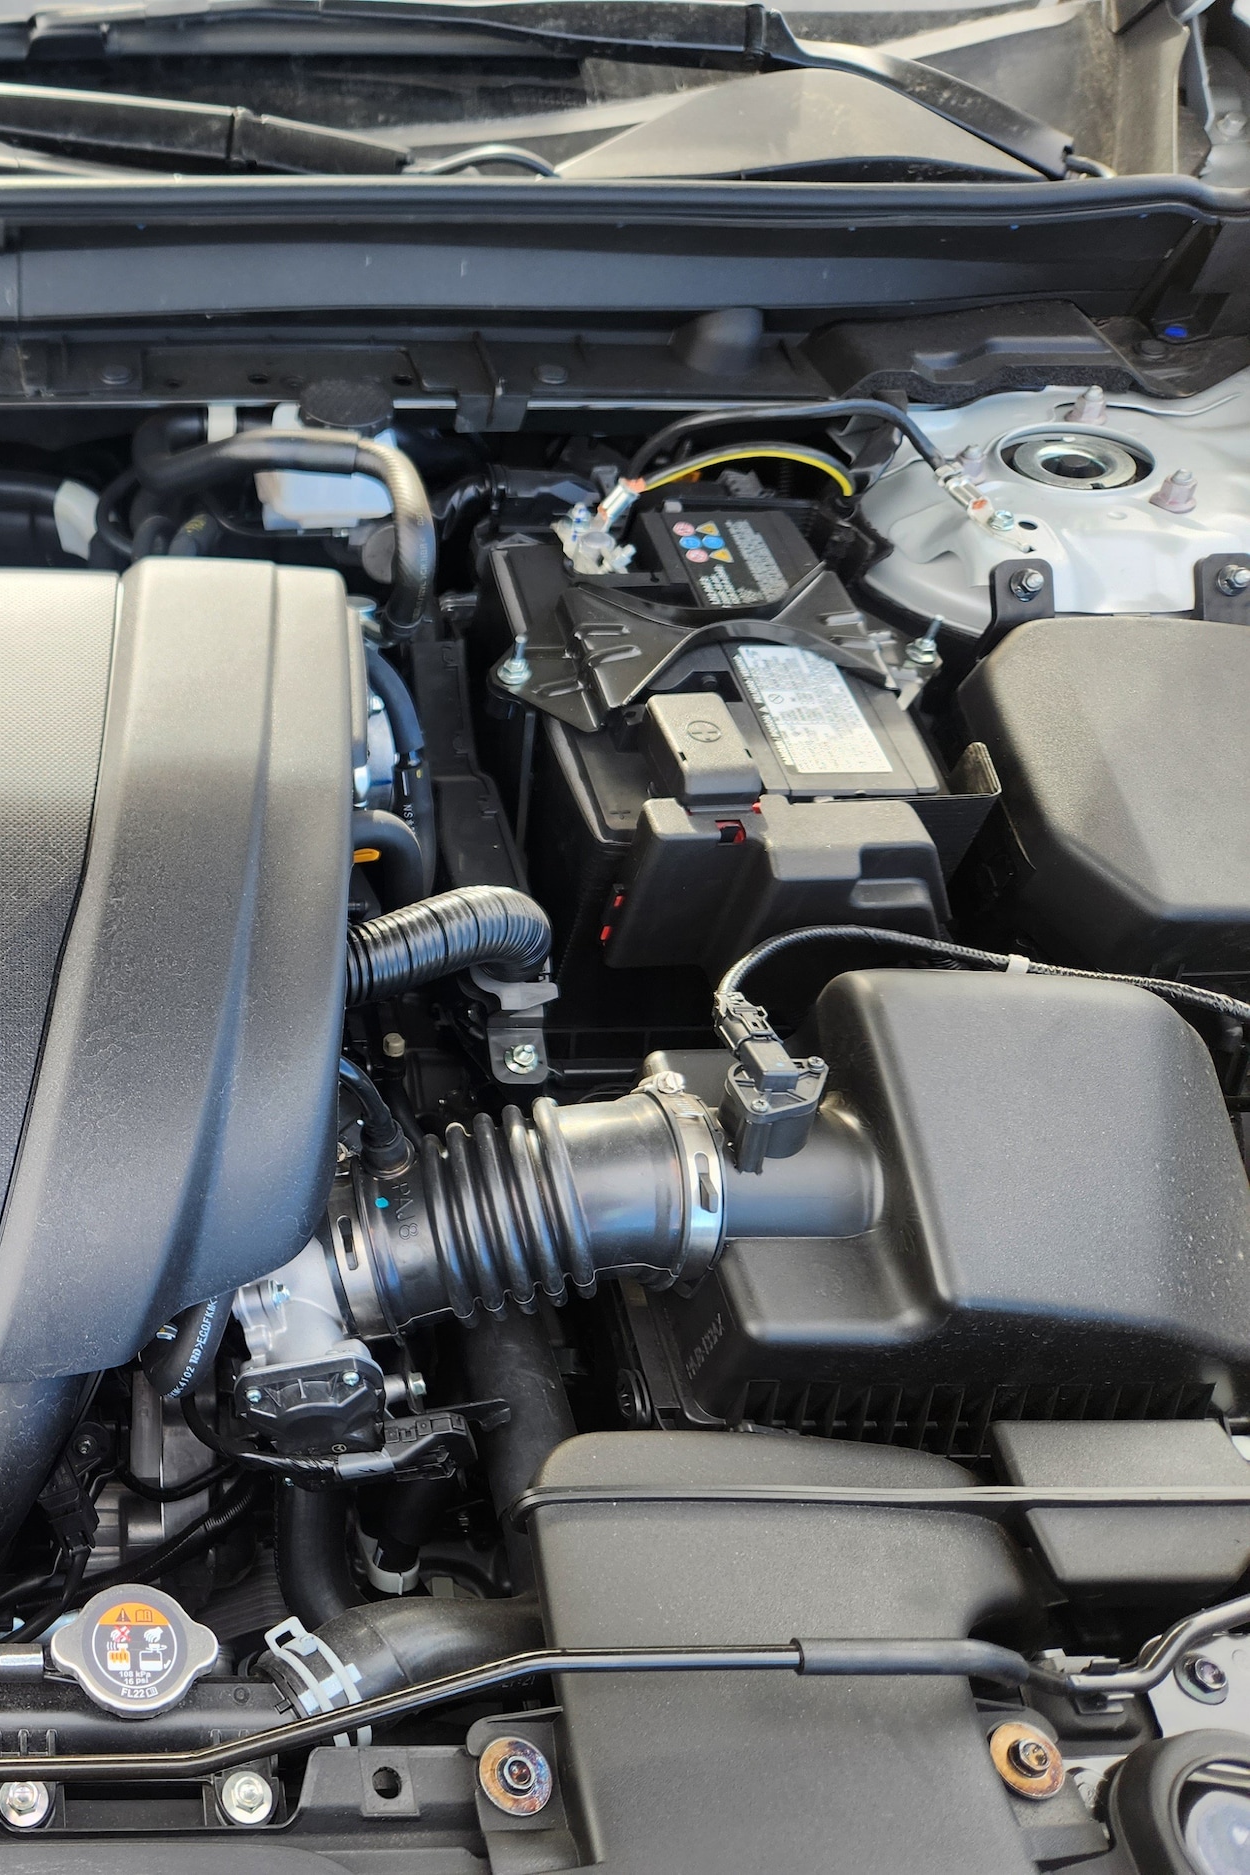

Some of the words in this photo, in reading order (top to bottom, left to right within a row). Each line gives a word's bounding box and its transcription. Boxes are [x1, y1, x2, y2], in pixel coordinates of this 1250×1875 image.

[118, 1670, 134, 1678] 108
[135, 1670, 151, 1678] kPa
[135, 1677, 149, 1685] psi
[120, 1687, 146, 1698] FL22
